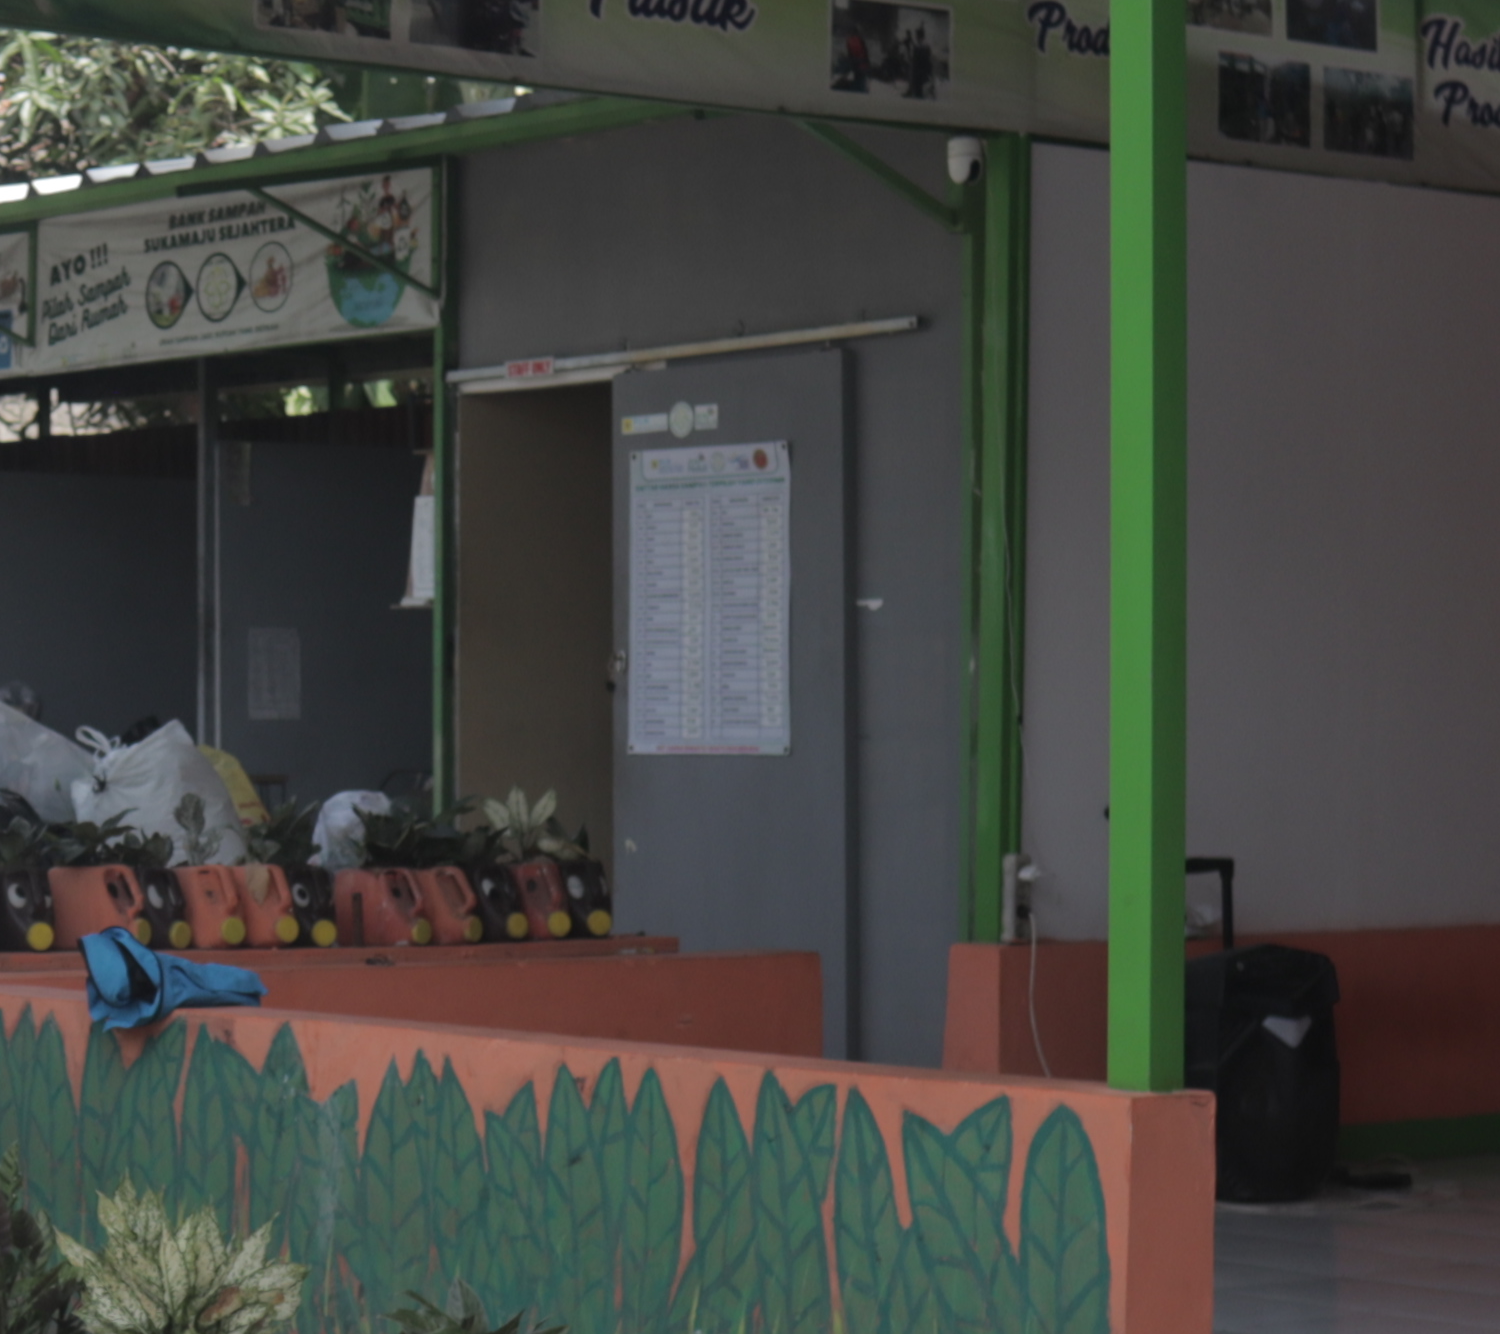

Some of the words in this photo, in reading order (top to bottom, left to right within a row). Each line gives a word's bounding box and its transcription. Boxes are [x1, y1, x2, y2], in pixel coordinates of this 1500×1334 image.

[143, 229, 216, 254] SUKAMAJU
[218, 216, 298, 242] SEJAHTERA
[168, 211, 207, 230] BANK
[49, 253, 86, 287] AYO
[77, 265, 132, 309] Sampah
[80, 293, 130, 333] Rumah
